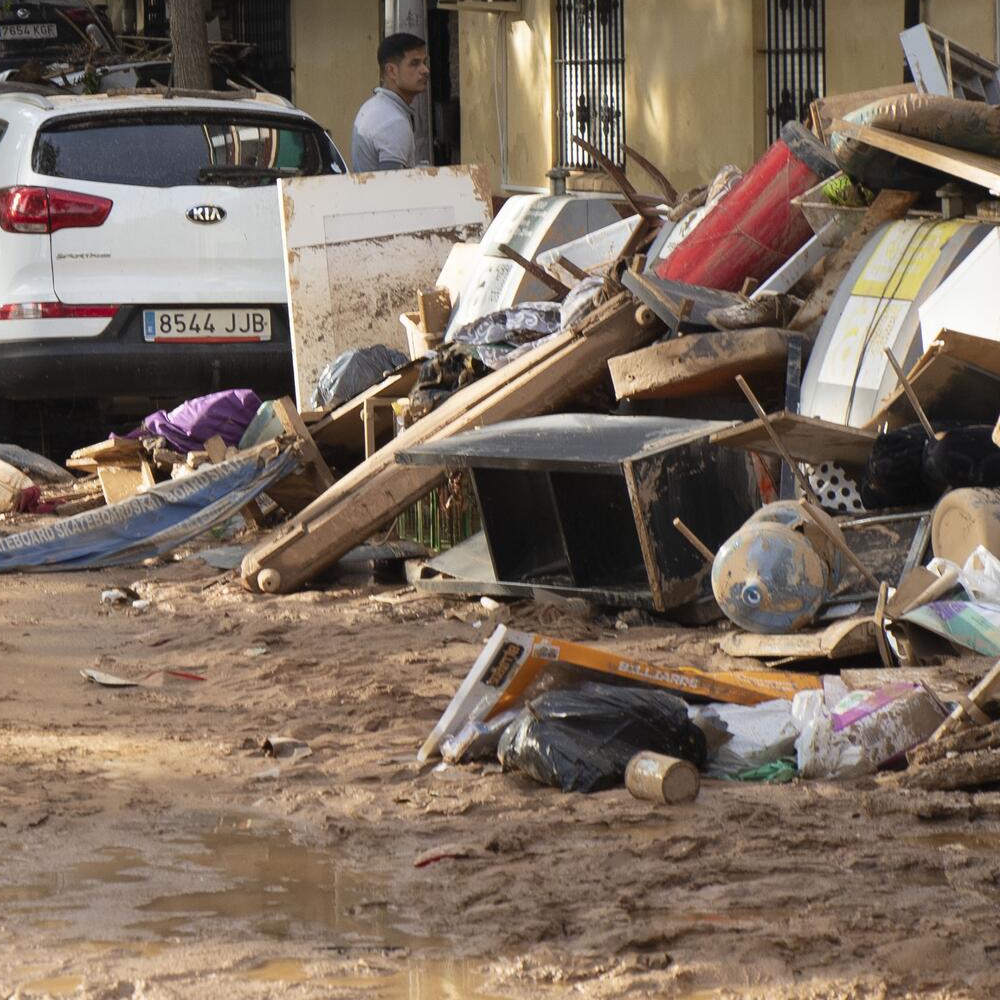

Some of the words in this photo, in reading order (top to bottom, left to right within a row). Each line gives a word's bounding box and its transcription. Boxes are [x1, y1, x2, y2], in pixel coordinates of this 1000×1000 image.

[2, 25, 31, 36] 7654
[193, 207, 222, 221] KIA
[160, 313, 216, 333] 8544
[225, 313, 265, 333] JJB
